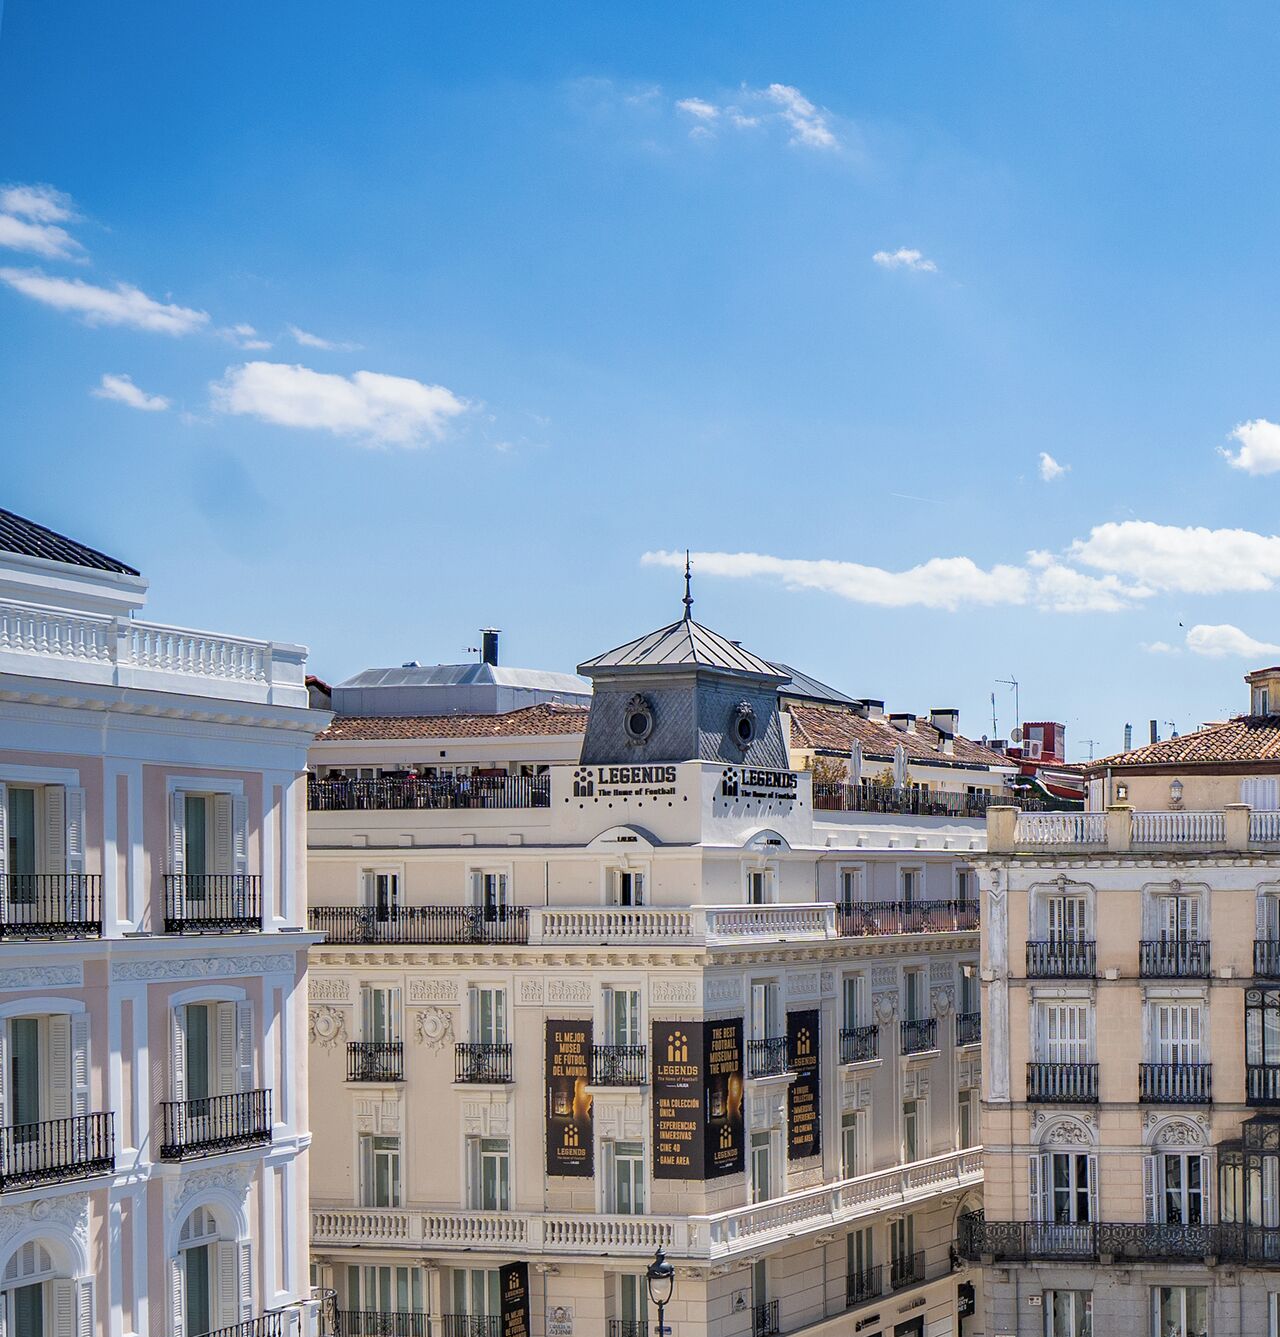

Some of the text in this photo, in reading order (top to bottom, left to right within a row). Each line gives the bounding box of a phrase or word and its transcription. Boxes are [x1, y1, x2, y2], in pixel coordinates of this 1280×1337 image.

[597, 766, 677, 785] LEGENDS
[740, 769, 798, 789] LEGENDS
[598, 789, 612, 797] The
[635, 787, 643, 796] of
[644, 787, 677, 796] Football
[555, 1032, 585, 1042] EL MEJOR
[712, 1026, 736, 1040] THE BEST
[559, 1043, 581, 1053] MUSEO
[711, 1039, 737, 1051] FOOTBALL
[554, 1053, 586, 1065] DE FÚTBOL
[709, 1050, 732, 1063] MUSEUM
[552, 1066, 588, 1076] DEL MUNDO
[657, 1065, 698, 1075] LEGENDS
[709, 1061, 739, 1075] THE WORLD
[659, 1097, 700, 1109] UNA COLECCIÓN
[659, 1108, 676, 1117] ÚNICA
[659, 1121, 697, 1131] EXPERIENCIAS
[659, 1131, 692, 1140] INMERSIVAS
[556, 1148, 586, 1156] LEGENDS
[659, 1144, 681, 1153] CINE 4D
[659, 1156, 690, 1165] GAME AREA
